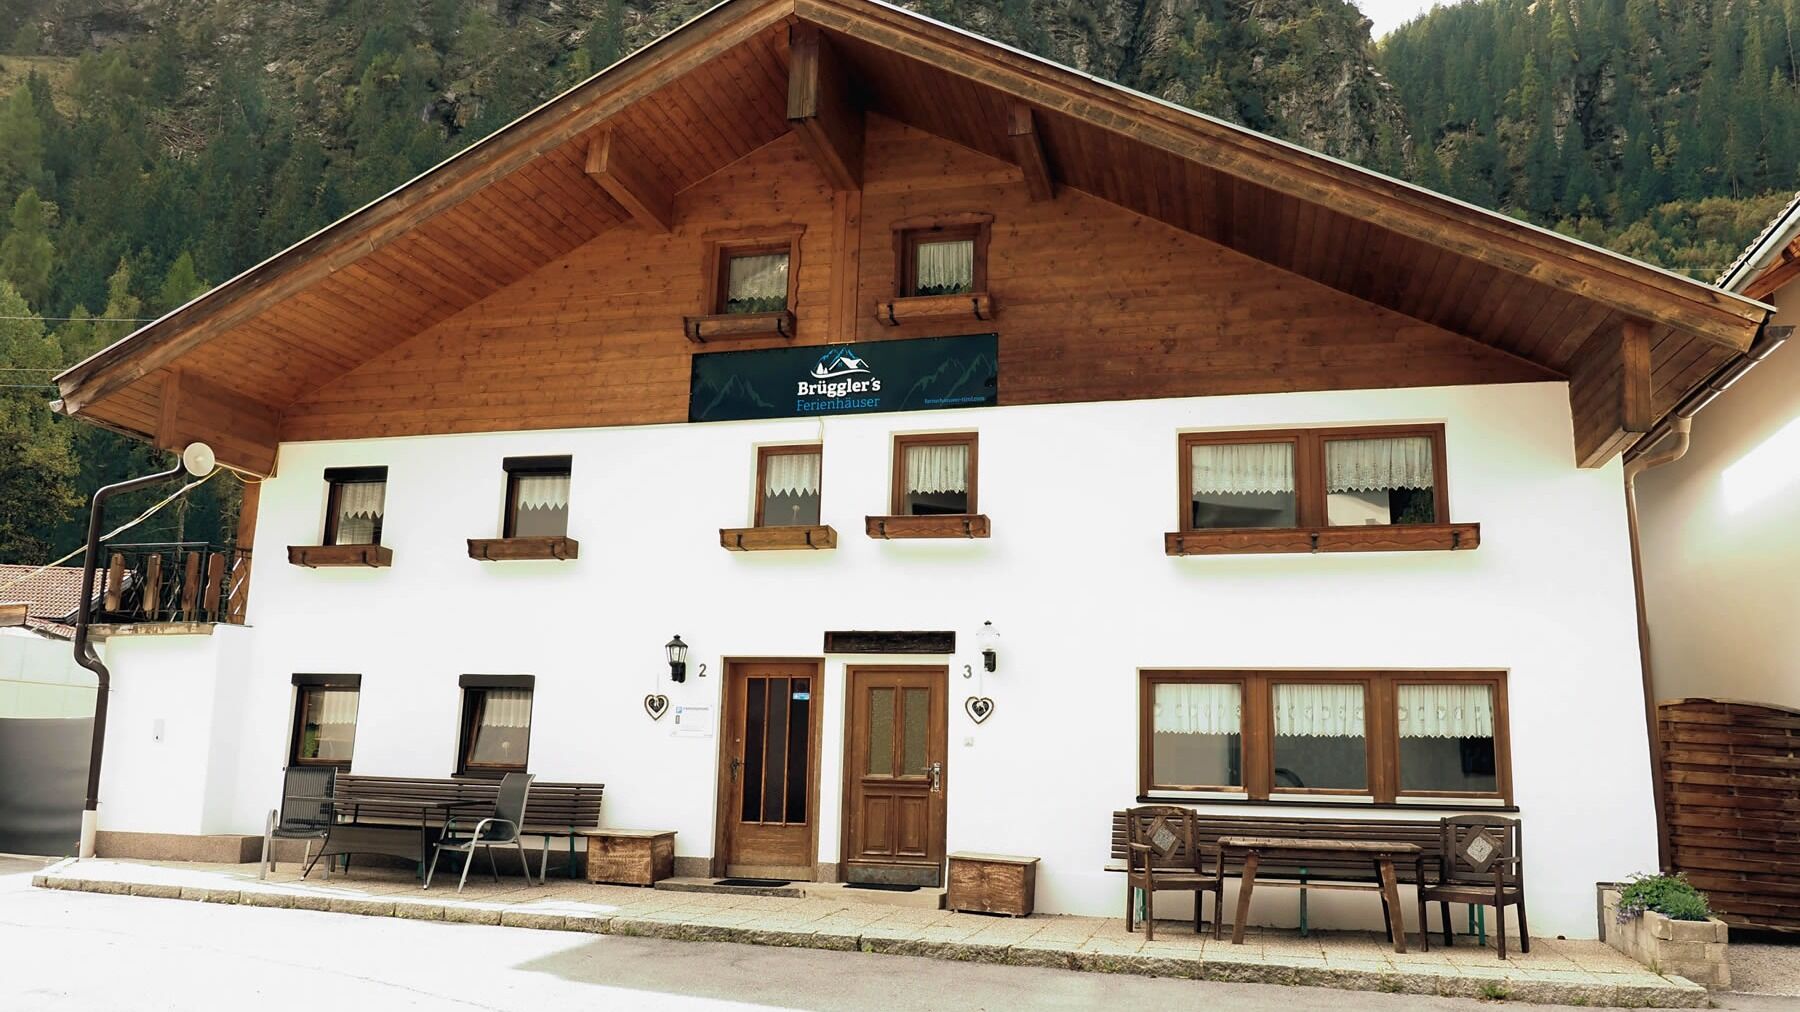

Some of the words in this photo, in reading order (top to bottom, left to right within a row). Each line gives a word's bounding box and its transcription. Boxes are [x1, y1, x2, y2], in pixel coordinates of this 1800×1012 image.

[796, 398, 881, 412] Ferienhäuser
[698, 663, 707, 678] 2
[963, 664, 972, 679] 3
